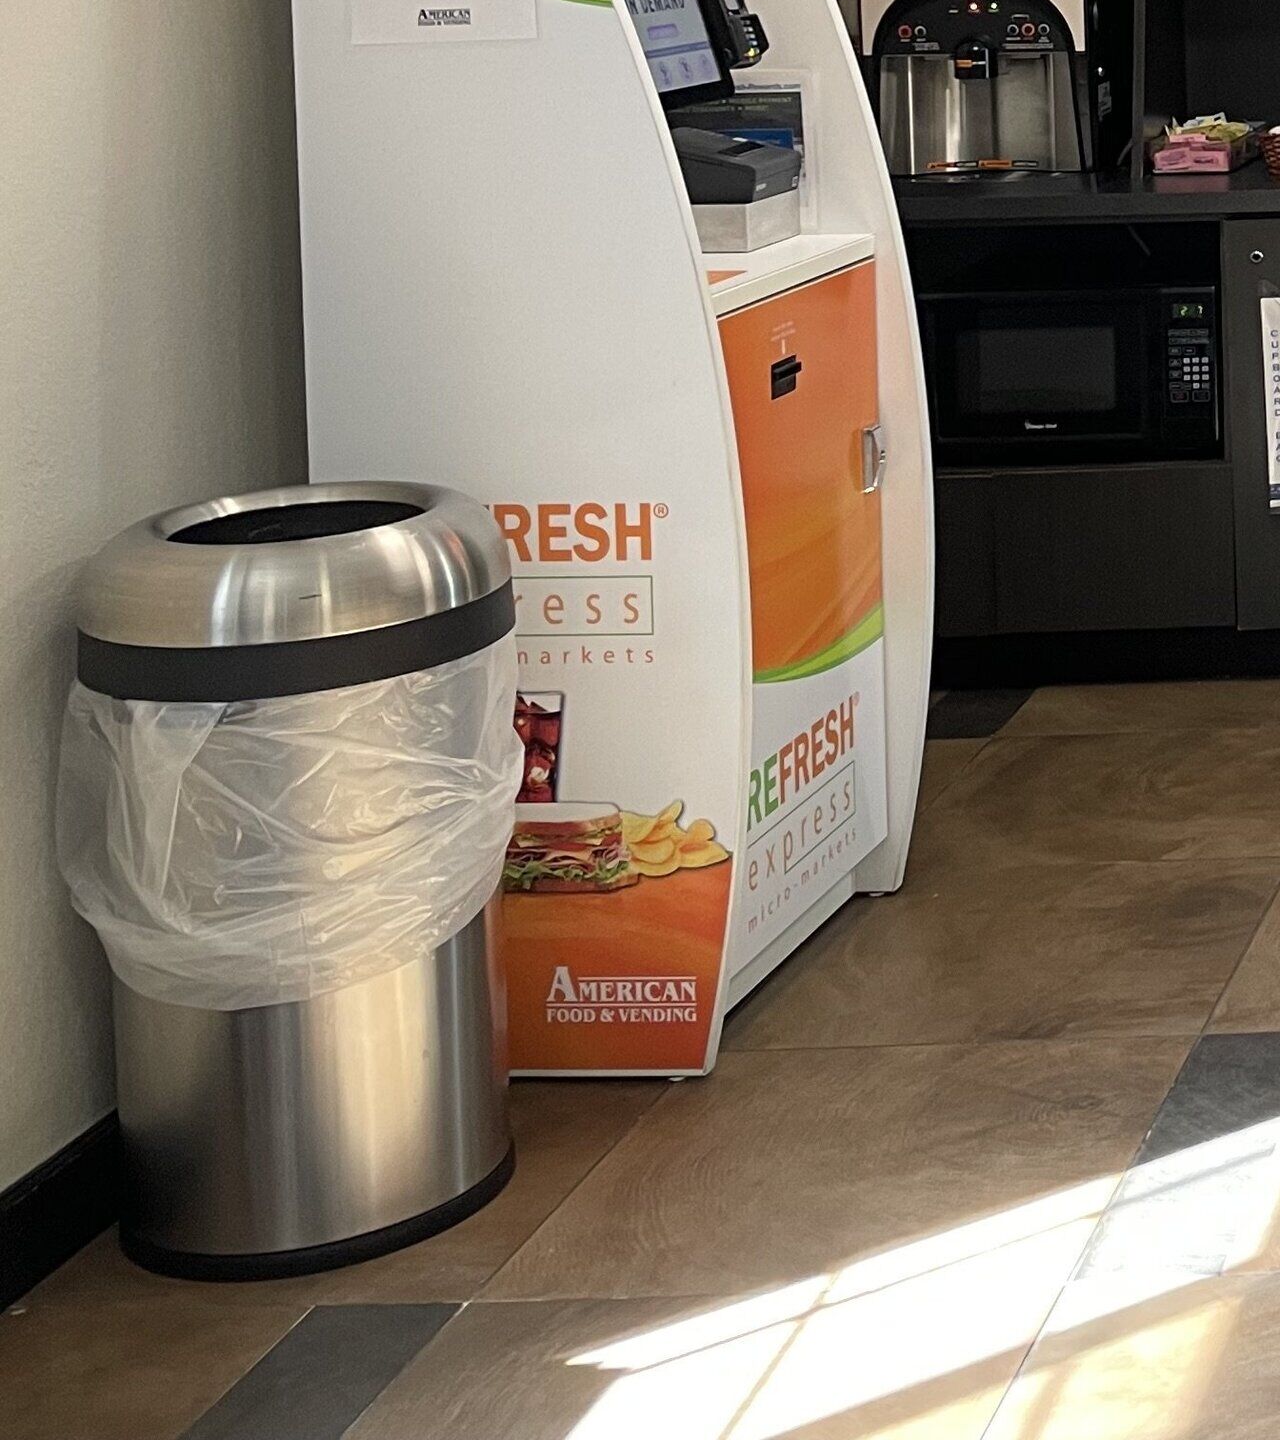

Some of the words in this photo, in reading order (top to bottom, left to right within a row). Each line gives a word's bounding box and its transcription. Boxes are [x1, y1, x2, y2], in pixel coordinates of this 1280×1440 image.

[418, 8, 470, 20] AMERICAN
[486, 503, 653, 562] RESH
[747, 696, 854, 832] REFRESH
[747, 778, 852, 891] express
[747, 826, 857, 933] micro-markets
[547, 966, 697, 1004] AMERICAN
[547, 1007, 596, 1023] FOOD
[600, 1007, 616, 1023] &
[619, 1006, 697, 1023] VENDING
